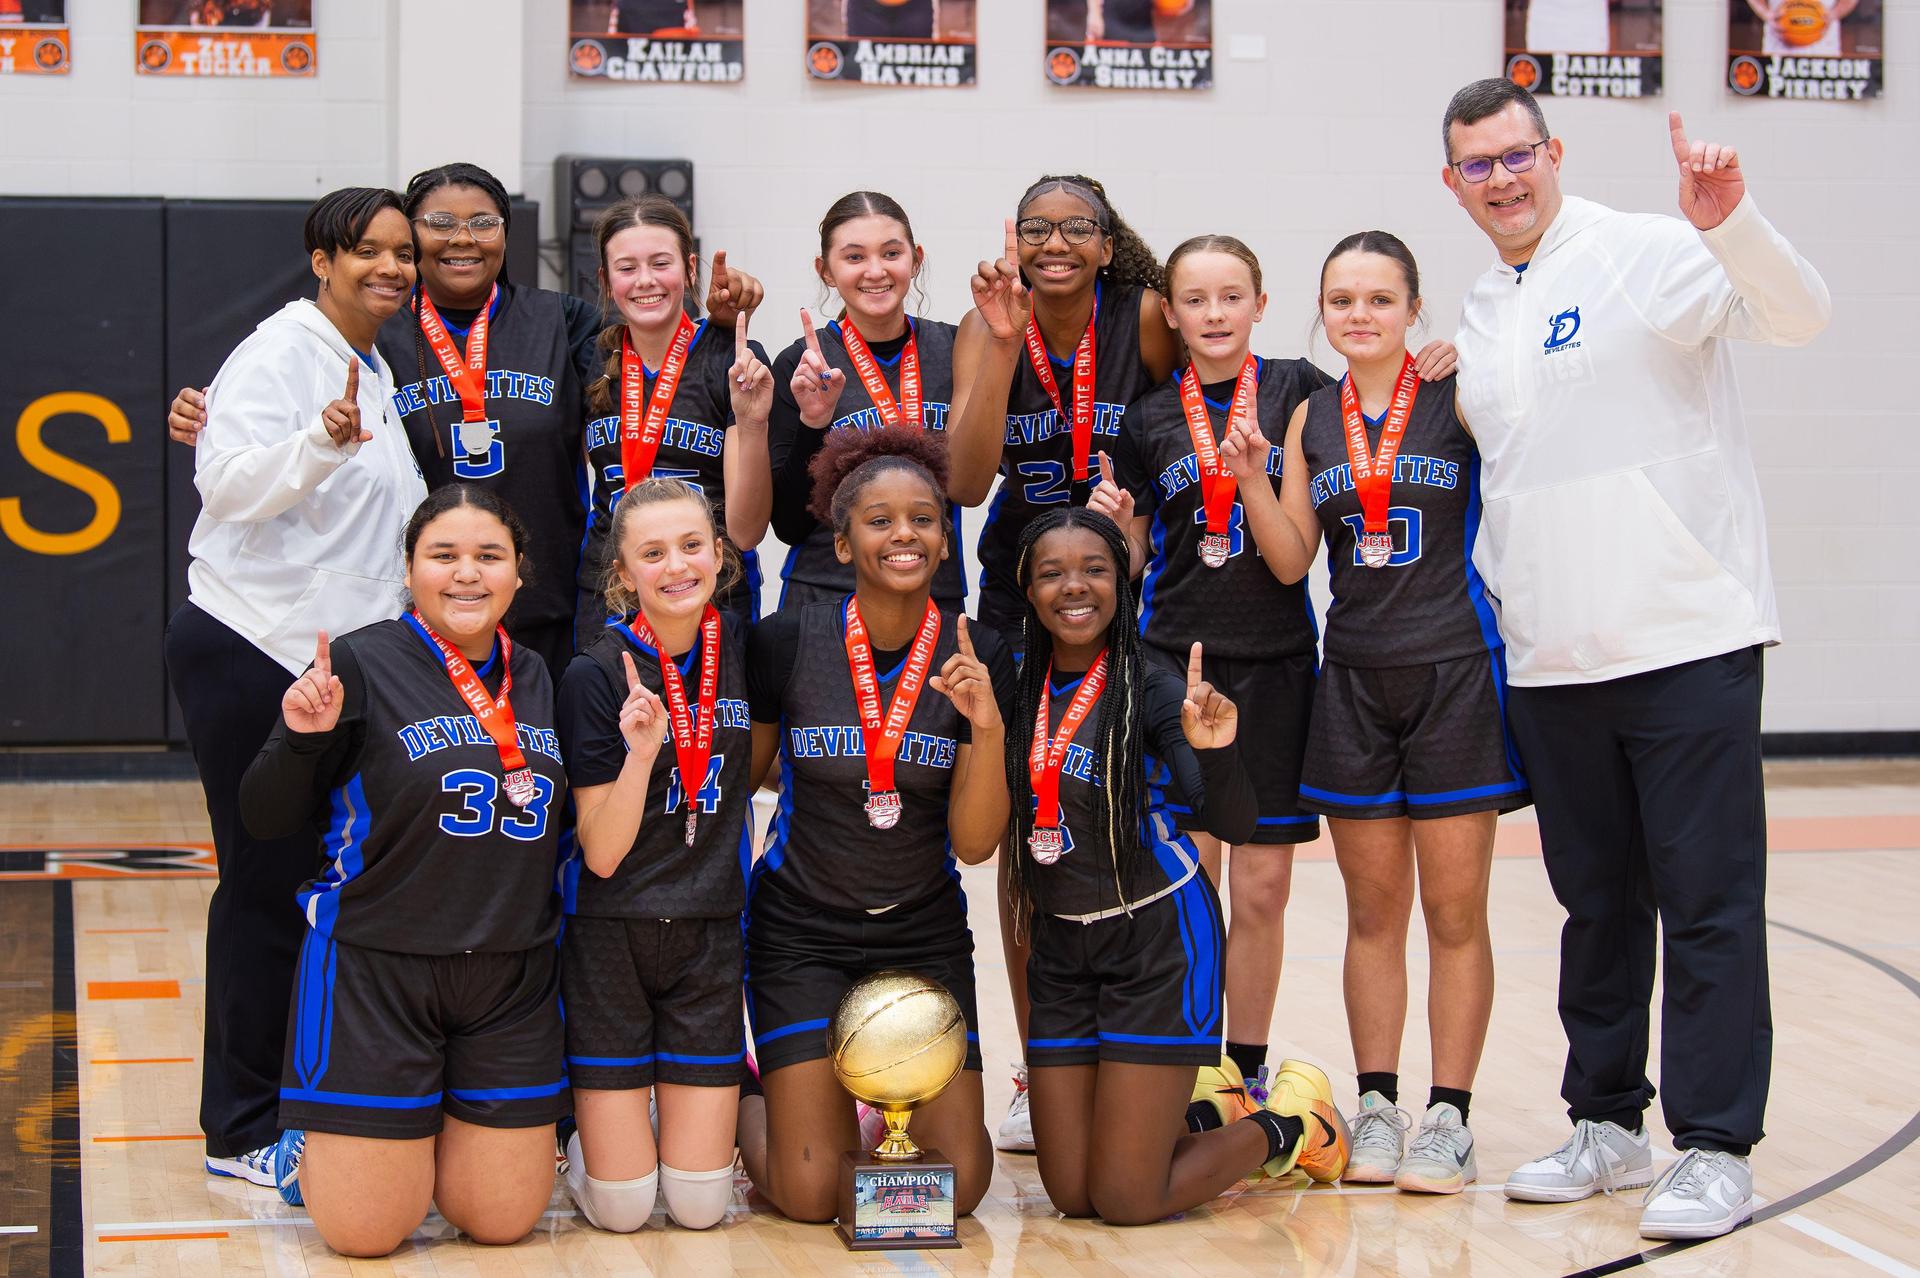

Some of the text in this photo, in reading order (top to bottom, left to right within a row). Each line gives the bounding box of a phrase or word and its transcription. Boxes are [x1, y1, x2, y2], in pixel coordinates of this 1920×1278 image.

[198, 38, 254, 58] ZETA
[627, 37, 723, 62] KAILAH
[1081, 44, 1210, 68] ANNA CLAY
[180, 53, 271, 75] TUCKER
[606, 56, 742, 82] CRAWFORD
[860, 61, 960, 86] HAYNES
[1094, 64, 1197, 88] SHIRLEY
[1552, 53, 1642, 76] DARIAN
[1765, 55, 1871, 79] JACKSON
[1552, 74, 1642, 96] COTTON
[437, 344, 463, 378] STATE
[844, 325, 885, 394] CHAMPIONS
[1544, 341, 1581, 355] DEVILETTES
[642, 327, 691, 445] STATE CHAMPIONS
[625, 363, 639, 440] CHAMPIONS
[1077, 384, 1091, 424] STATE
[451, 420, 505, 479] 5
[1189, 404, 1218, 476] CHAMPIONS
[1346, 410, 1371, 479] CHAMPIONS
[1375, 439, 1396, 476] STATE
[1200, 535, 1231, 550] JCH
[1358, 535, 1392, 549] JCH
[698, 618, 718, 749] STATE CHAMPION
[852, 643, 881, 730] CHAMPIONS
[885, 609, 939, 739] STATE CHAMPIONS
[461, 678, 493, 718] STATE
[665, 663, 691, 748] CHAMPIONS
[1048, 726, 1072, 767] STATE
[503, 770, 534, 789] JCH
[439, 768, 554, 841] 33
[865, 794, 901, 810] JCH
[1029, 831, 1062, 845] JCH
[869, 1175, 940, 1187] CHAMPION
